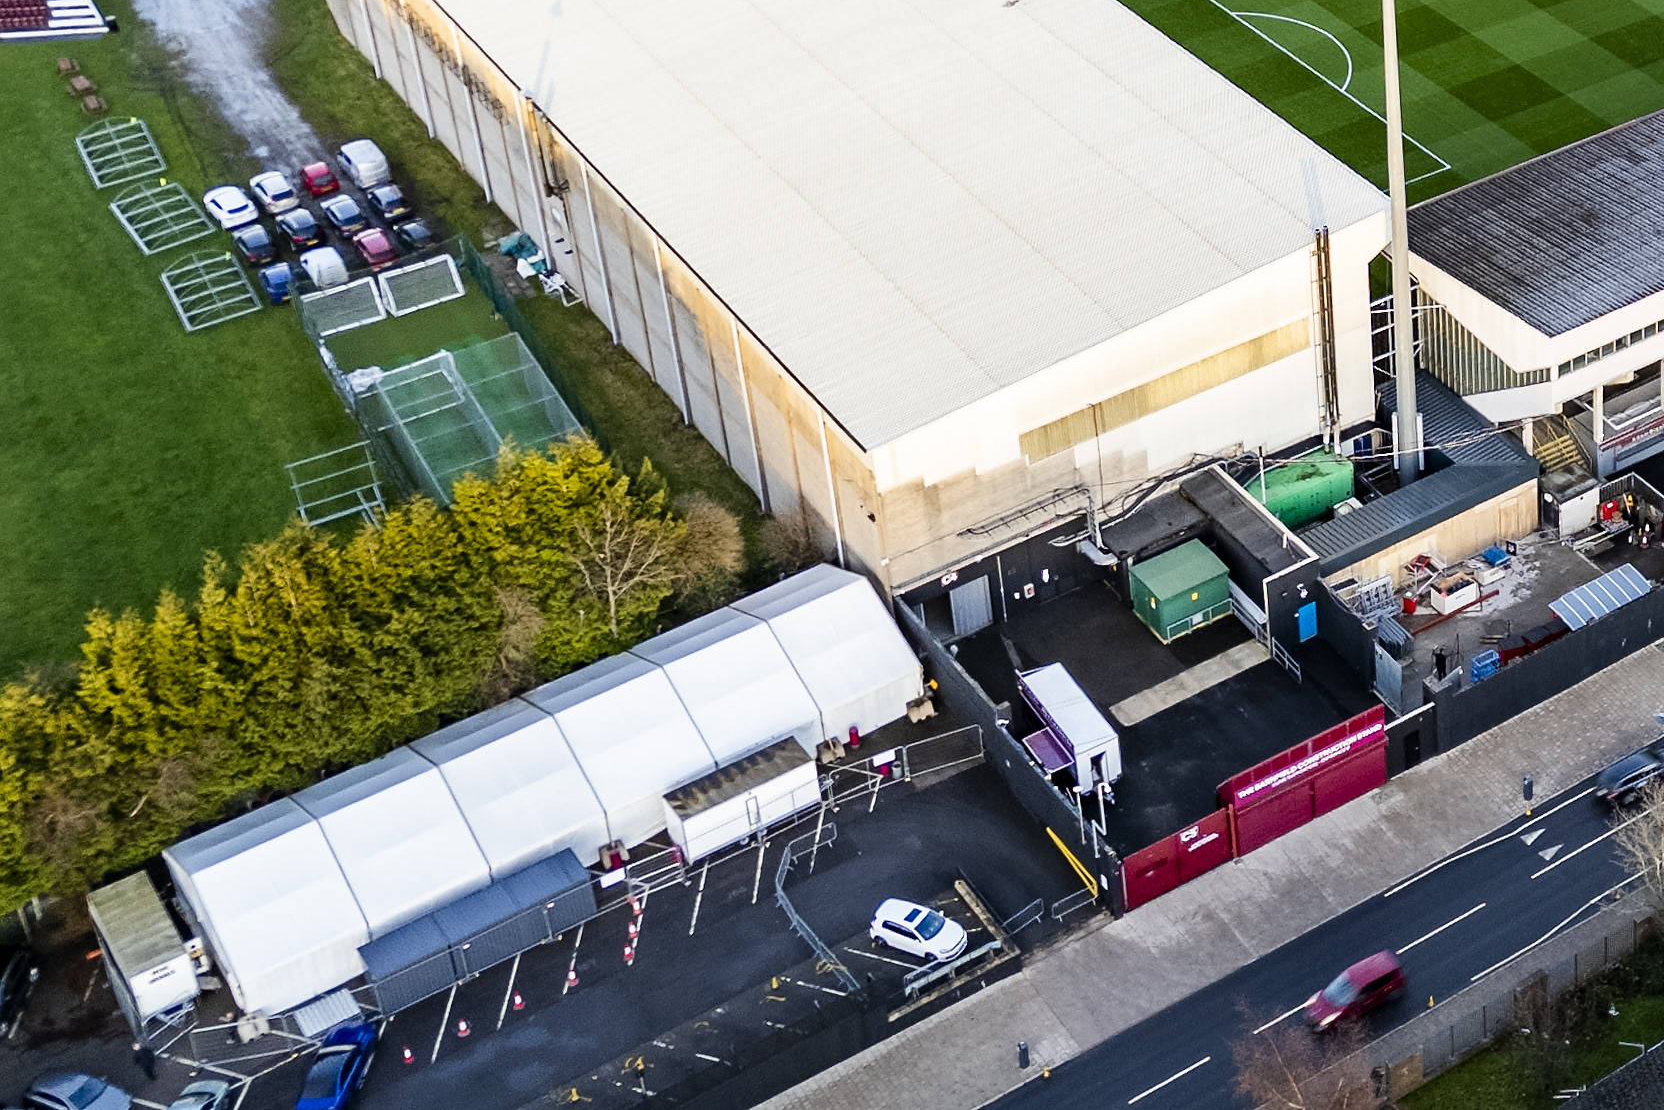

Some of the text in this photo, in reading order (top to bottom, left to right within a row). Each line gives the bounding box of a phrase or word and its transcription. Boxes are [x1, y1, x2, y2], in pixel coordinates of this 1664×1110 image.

[1237, 786, 1255, 799] THE
[1255, 765, 1298, 793] BARNFIELD
[1298, 734, 1357, 771] CONSTRUCTION
[1357, 722, 1384, 742] STAND
